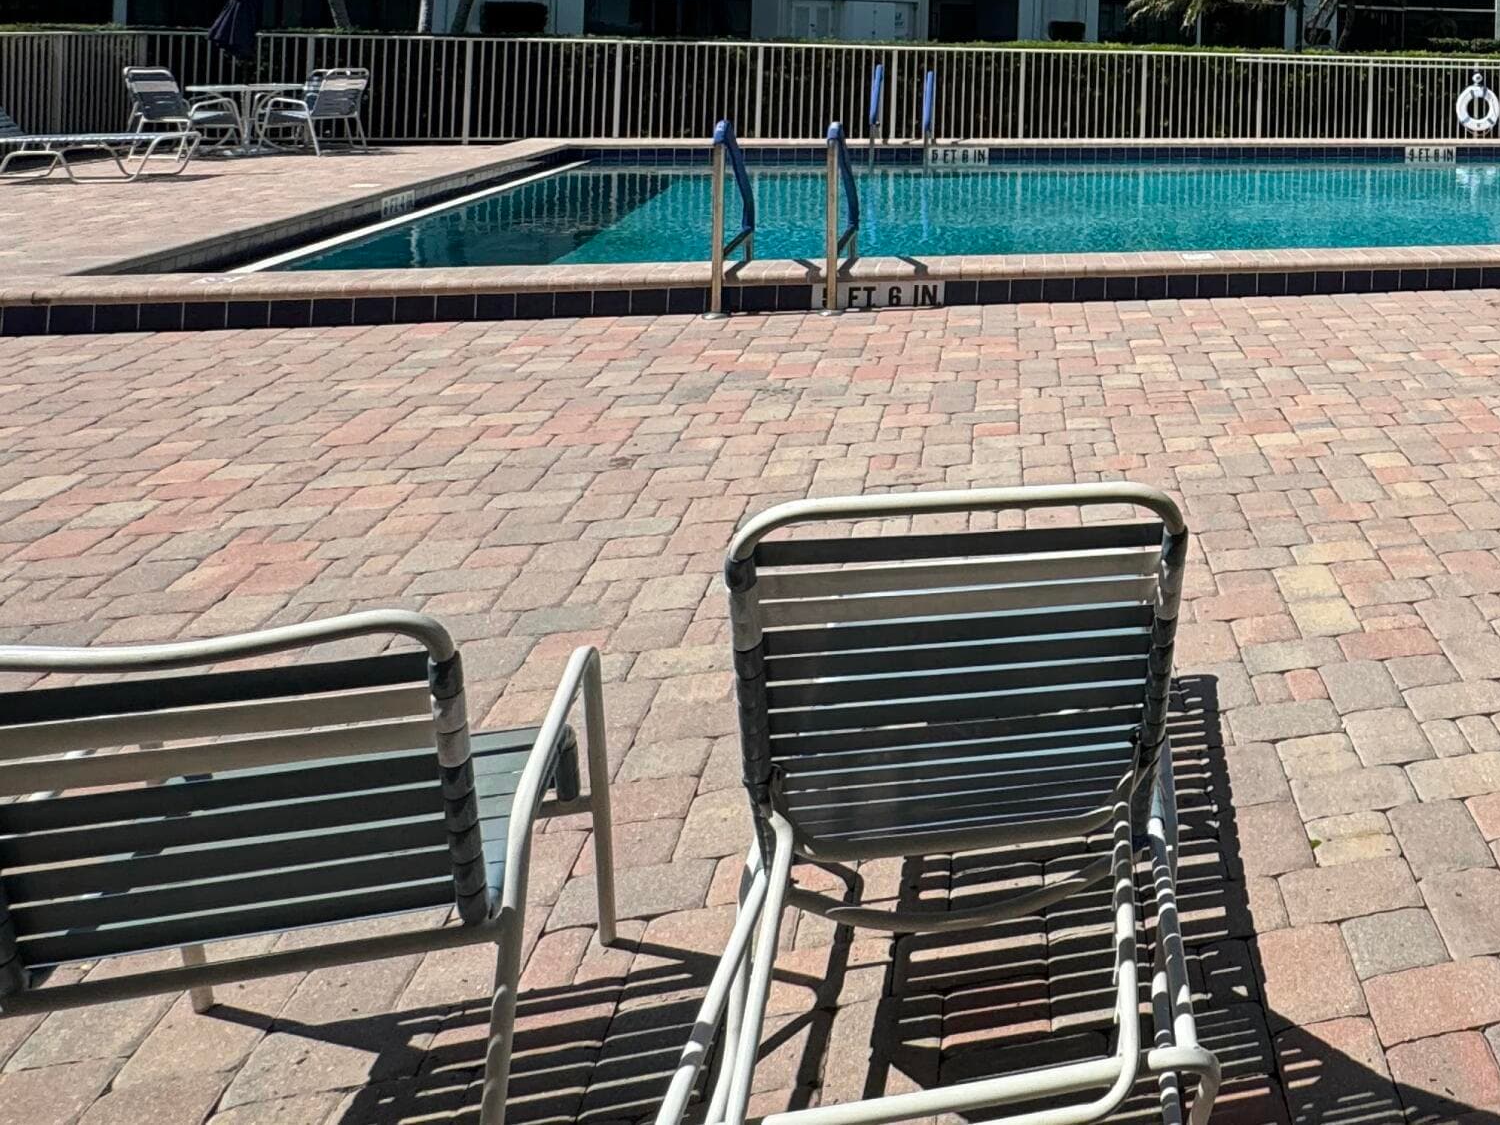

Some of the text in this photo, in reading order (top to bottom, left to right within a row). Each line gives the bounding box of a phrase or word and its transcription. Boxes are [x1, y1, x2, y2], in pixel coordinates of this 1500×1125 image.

[943, 149, 957, 164] FT
[973, 149, 986, 164] IN
[1418, 148, 1431, 163] FT
[1443, 148, 1454, 163] IN
[888, 286, 902, 307] 6
